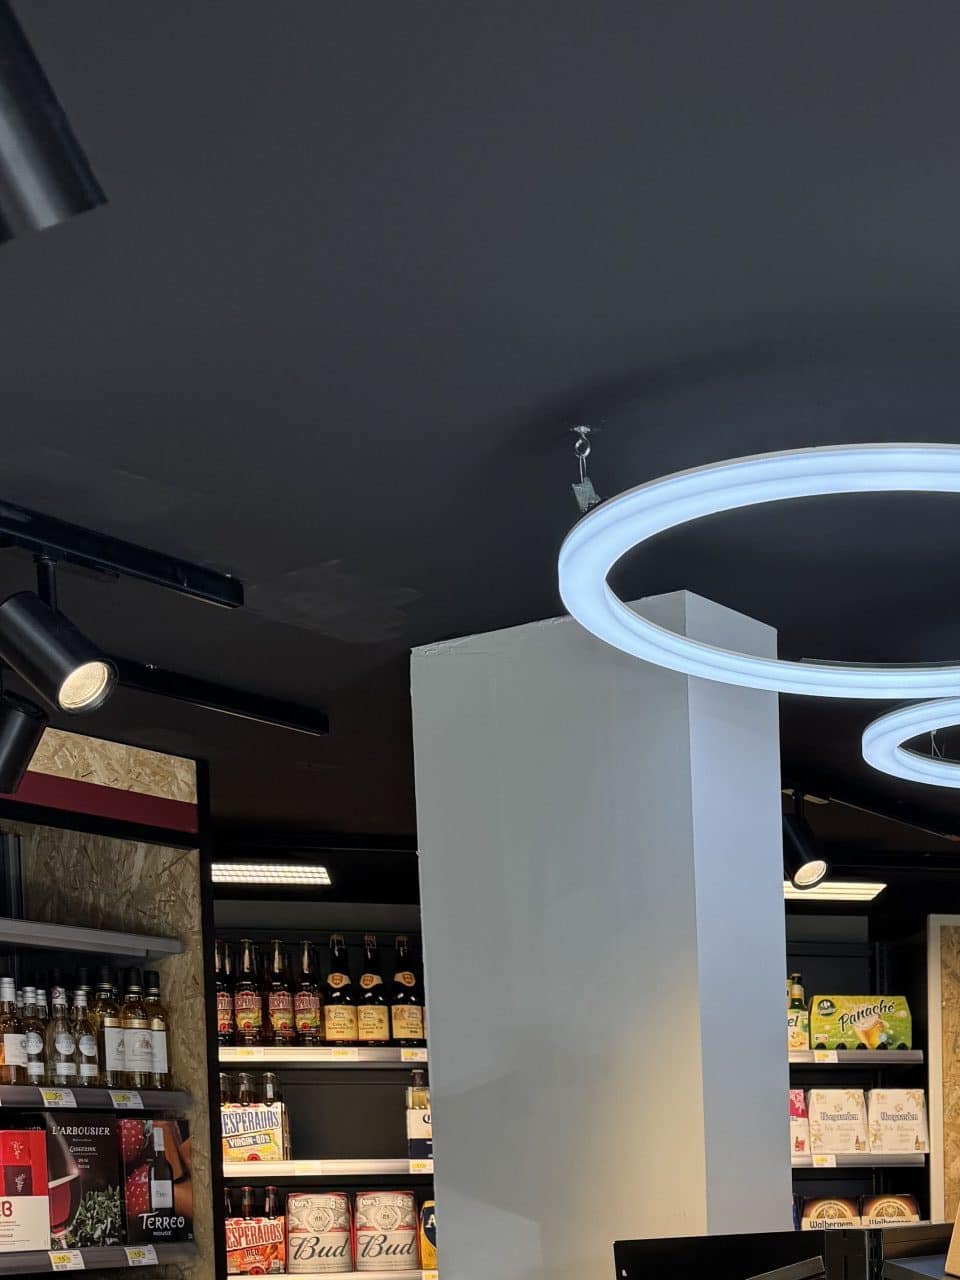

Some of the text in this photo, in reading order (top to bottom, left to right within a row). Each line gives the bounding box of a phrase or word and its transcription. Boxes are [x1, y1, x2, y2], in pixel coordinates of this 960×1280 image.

[838, 1000, 896, 1033] Panaché
[52, 1126, 110, 1136] L'ARBOUSIER
[138, 1211, 185, 1229] TERREO
[290, 1236, 349, 1260] Bud
[358, 1233, 416, 1258] Bud
